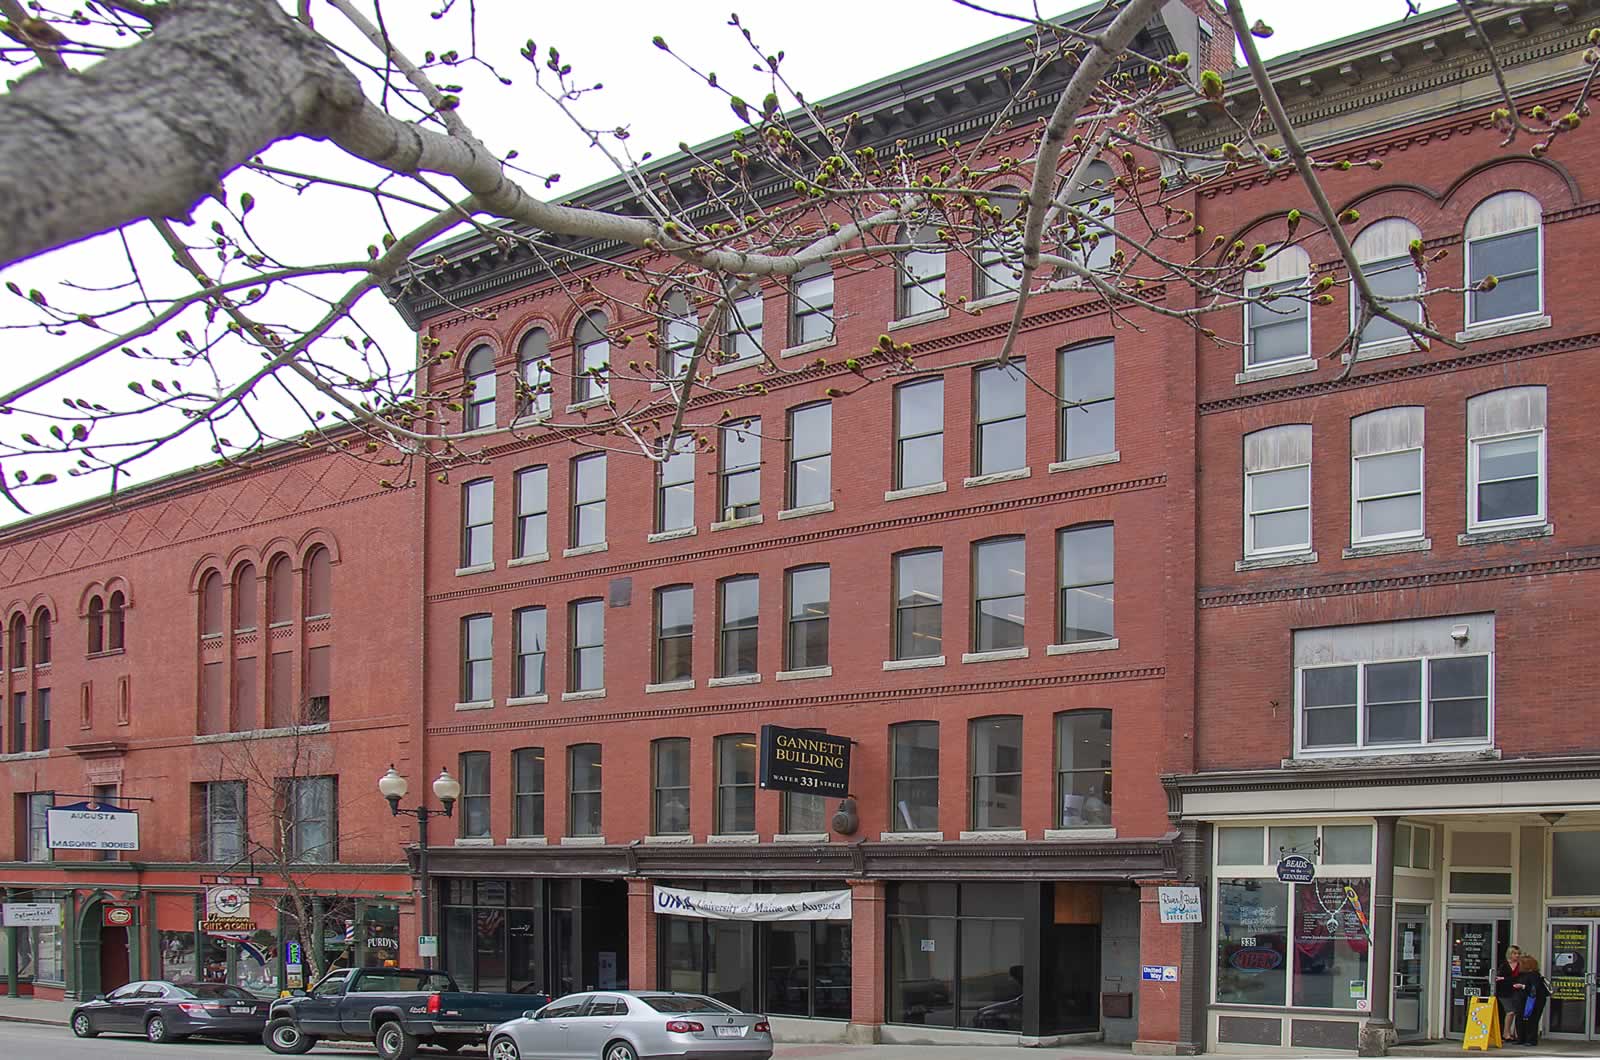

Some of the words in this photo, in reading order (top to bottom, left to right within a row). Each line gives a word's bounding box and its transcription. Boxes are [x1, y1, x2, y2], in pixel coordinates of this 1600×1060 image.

[776, 735, 845, 755] GANNETT
[776, 748, 844, 769] BUILDING
[772, 774, 799, 783] WATER
[800, 776, 818, 788] 331
[819, 780, 845, 789] STREET
[70, 812, 117, 821] AUGUSTA
[52, 840, 97, 848] MASONIC
[101, 841, 136, 849] BODIES
[1285, 859, 1308, 869] BEADS
[697, 900, 738, 914] University
[741, 901, 750, 914] of
[753, 902, 784, 913] Maine
[787, 903, 798, 912] at
[802, 901, 842, 914] Augusta
[1150, 973, 1162, 981] Way
